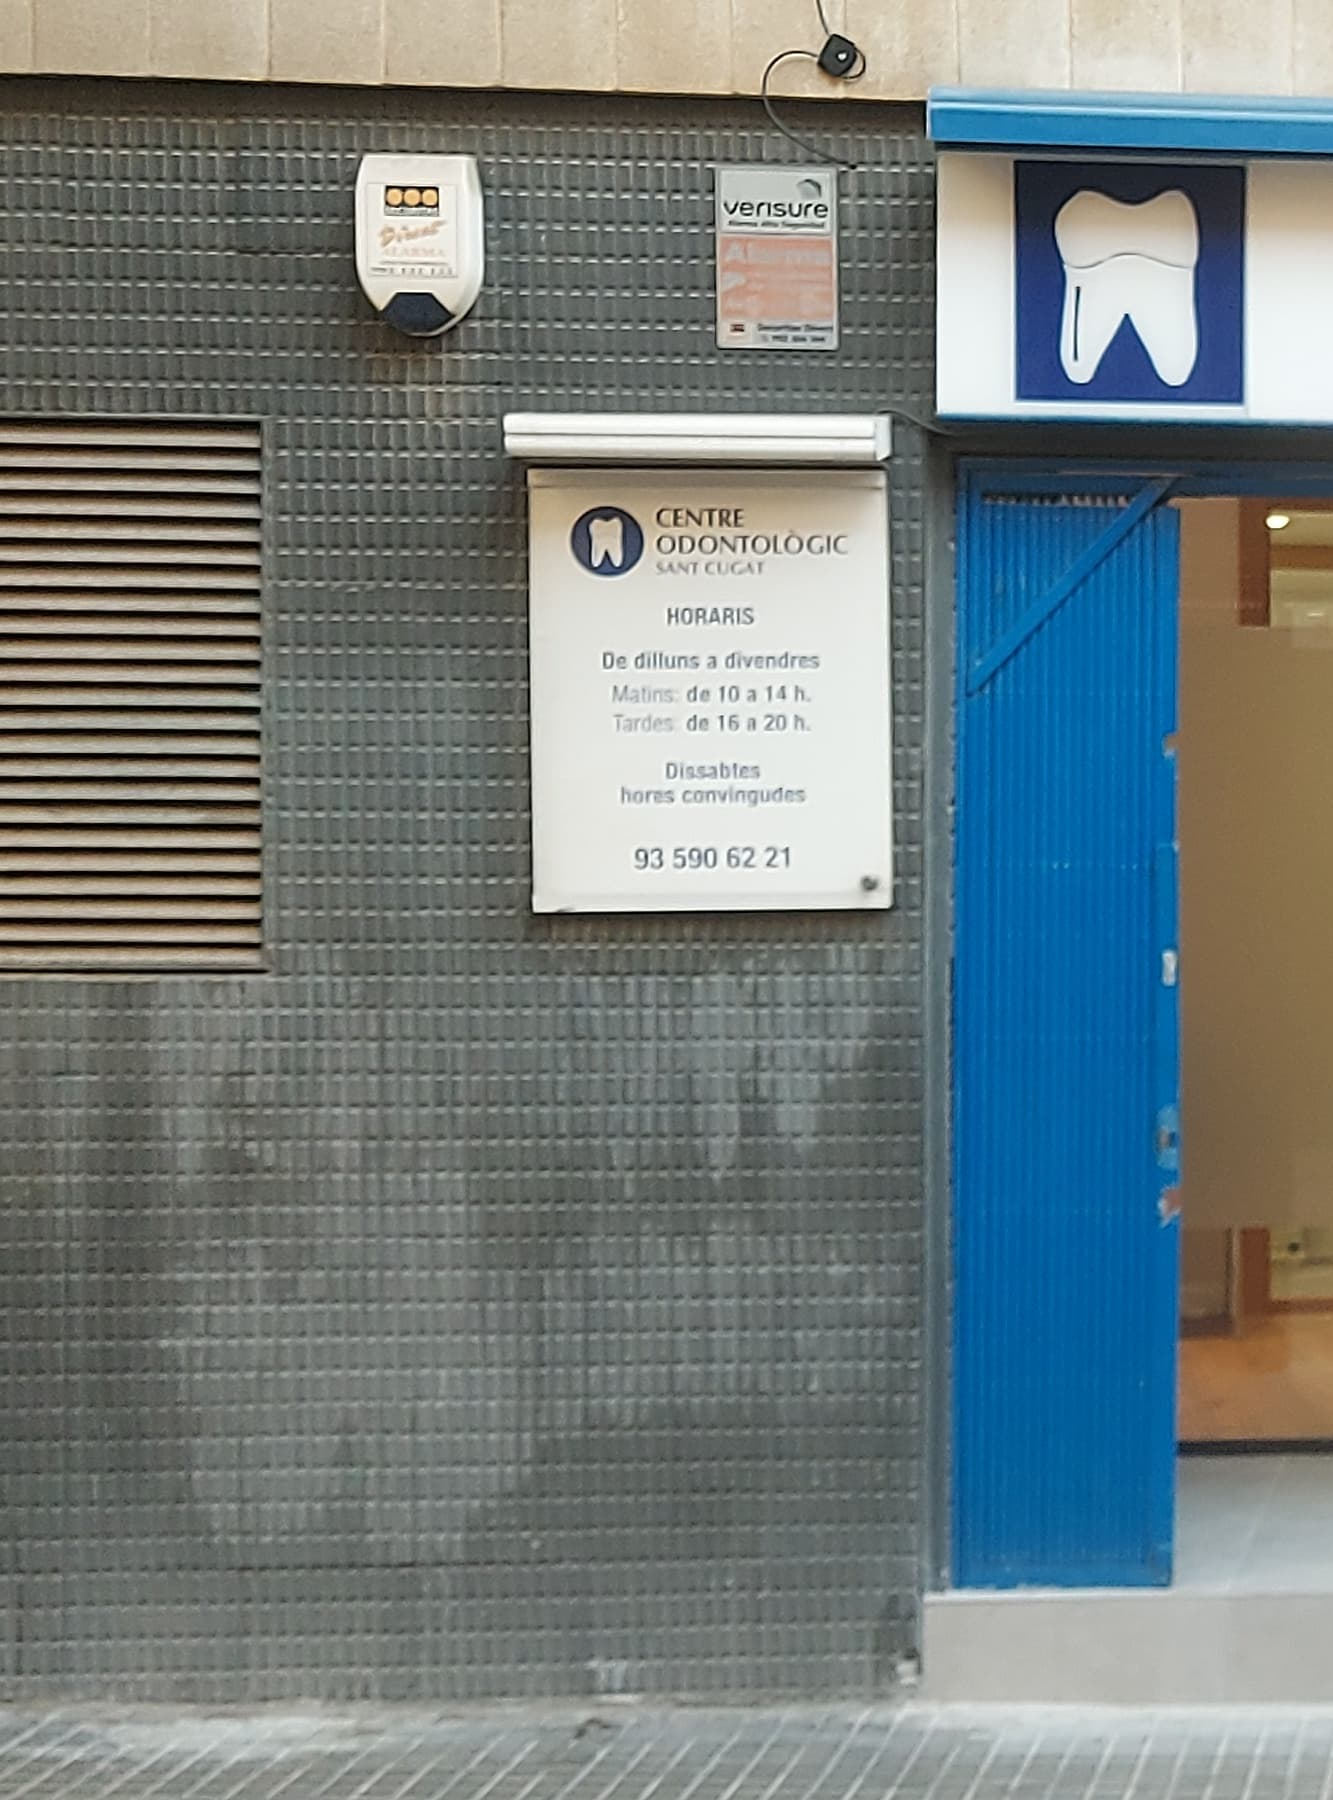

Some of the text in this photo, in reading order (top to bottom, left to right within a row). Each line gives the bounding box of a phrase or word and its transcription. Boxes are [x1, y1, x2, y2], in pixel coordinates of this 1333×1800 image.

[723, 200, 829, 218] verisure
[656, 507, 745, 528] CENTRE
[656, 528, 849, 556] ODONTOLÒGIC
[656, 560, 765, 577] SANT CUGAT
[666, 607, 755, 626] HORARIS
[602, 651, 820, 671] De dilluns a divendres
[686, 684, 711, 703] de
[718, 685, 740, 703] 10
[746, 689, 757, 703] a
[764, 685, 788, 704] 14
[793, 685, 812, 704] h.
[686, 713, 710, 732] de
[717, 714, 740, 732] 16
[746, 718, 757, 732] a
[763, 714, 787, 733] 20
[665, 762, 761, 781] Dissabtes
[620, 785, 806, 808] hores convingudes
[634, 846, 790, 870] 93 590 62 21
